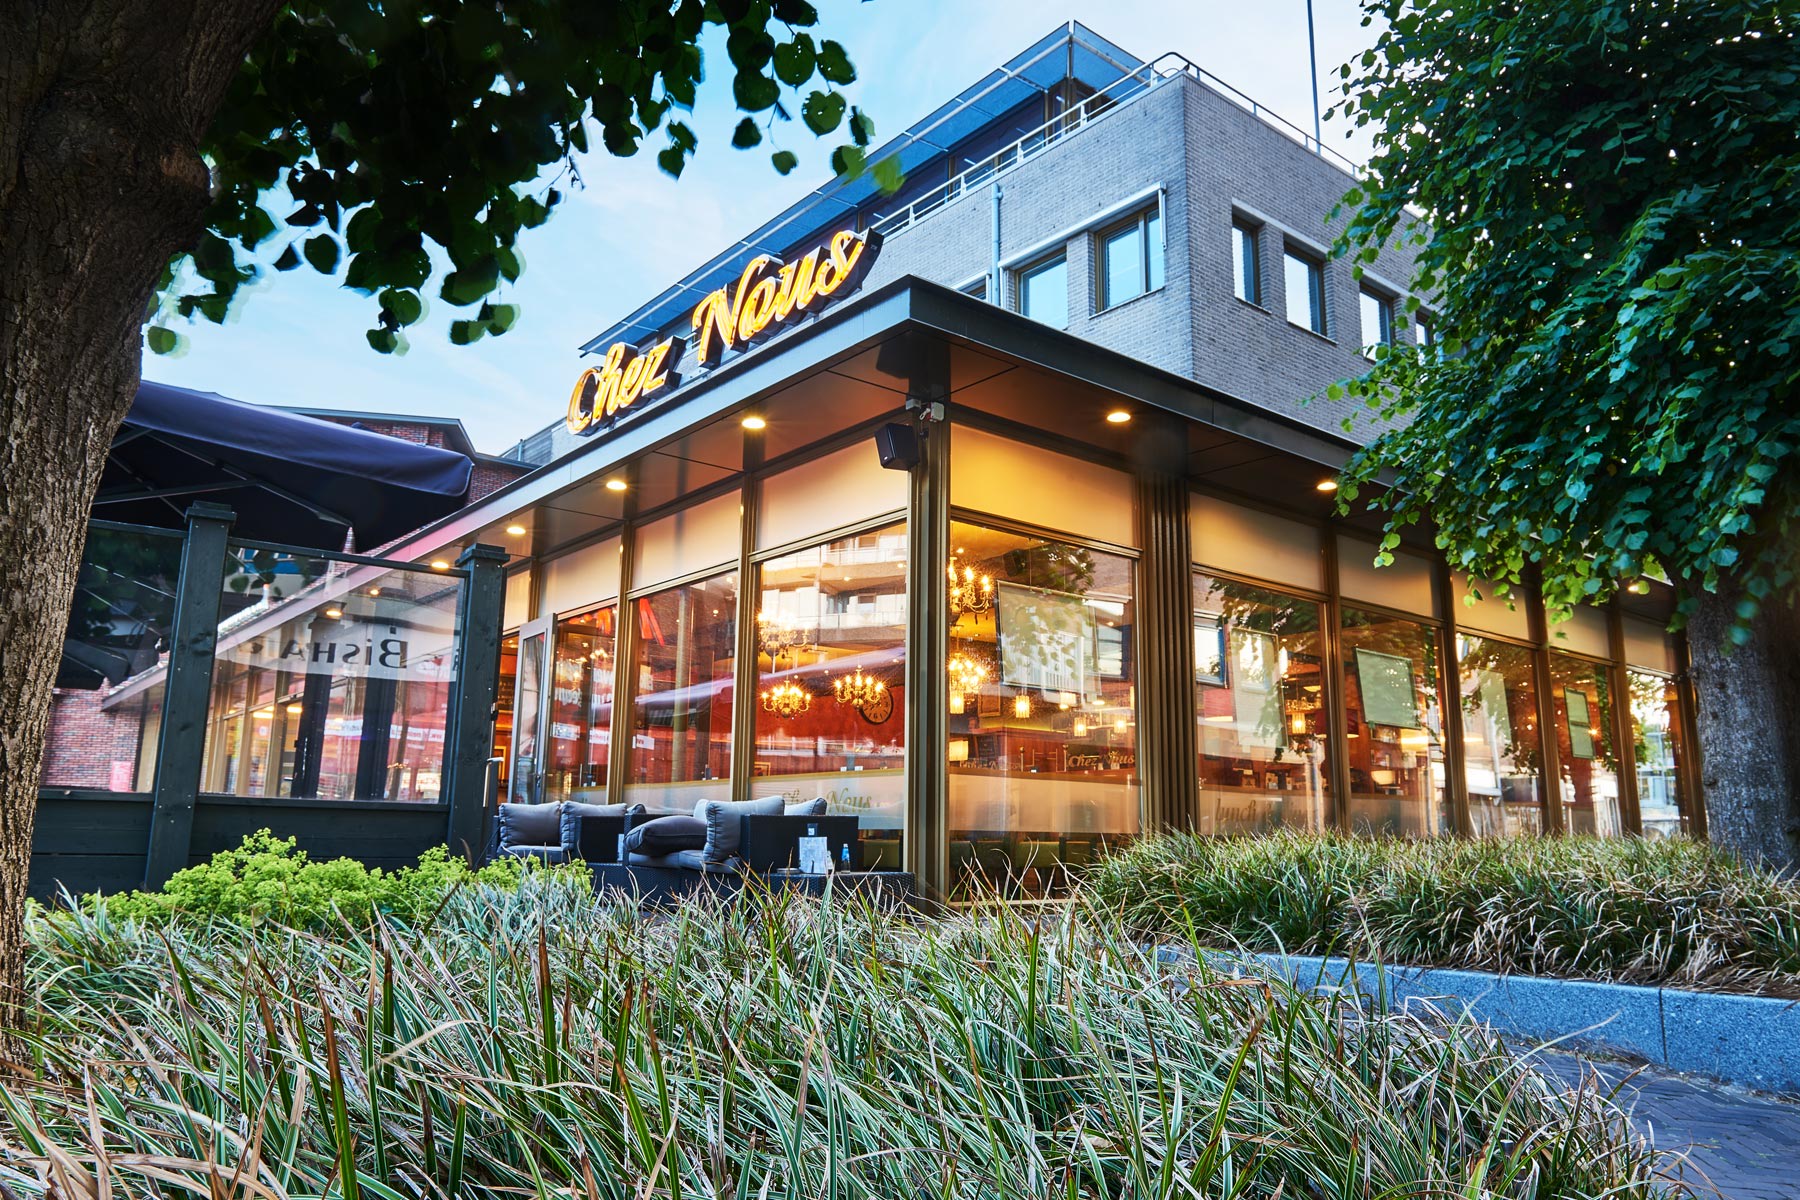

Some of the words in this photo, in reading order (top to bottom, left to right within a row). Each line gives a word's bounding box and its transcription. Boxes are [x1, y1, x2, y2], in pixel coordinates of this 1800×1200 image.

[566, 341, 673, 436] Chez
[691, 229, 866, 363] Nous
[1068, 753, 1098, 768] Chez
[1100, 753, 1136, 767] Nus
[826, 787, 872, 814] Nous
